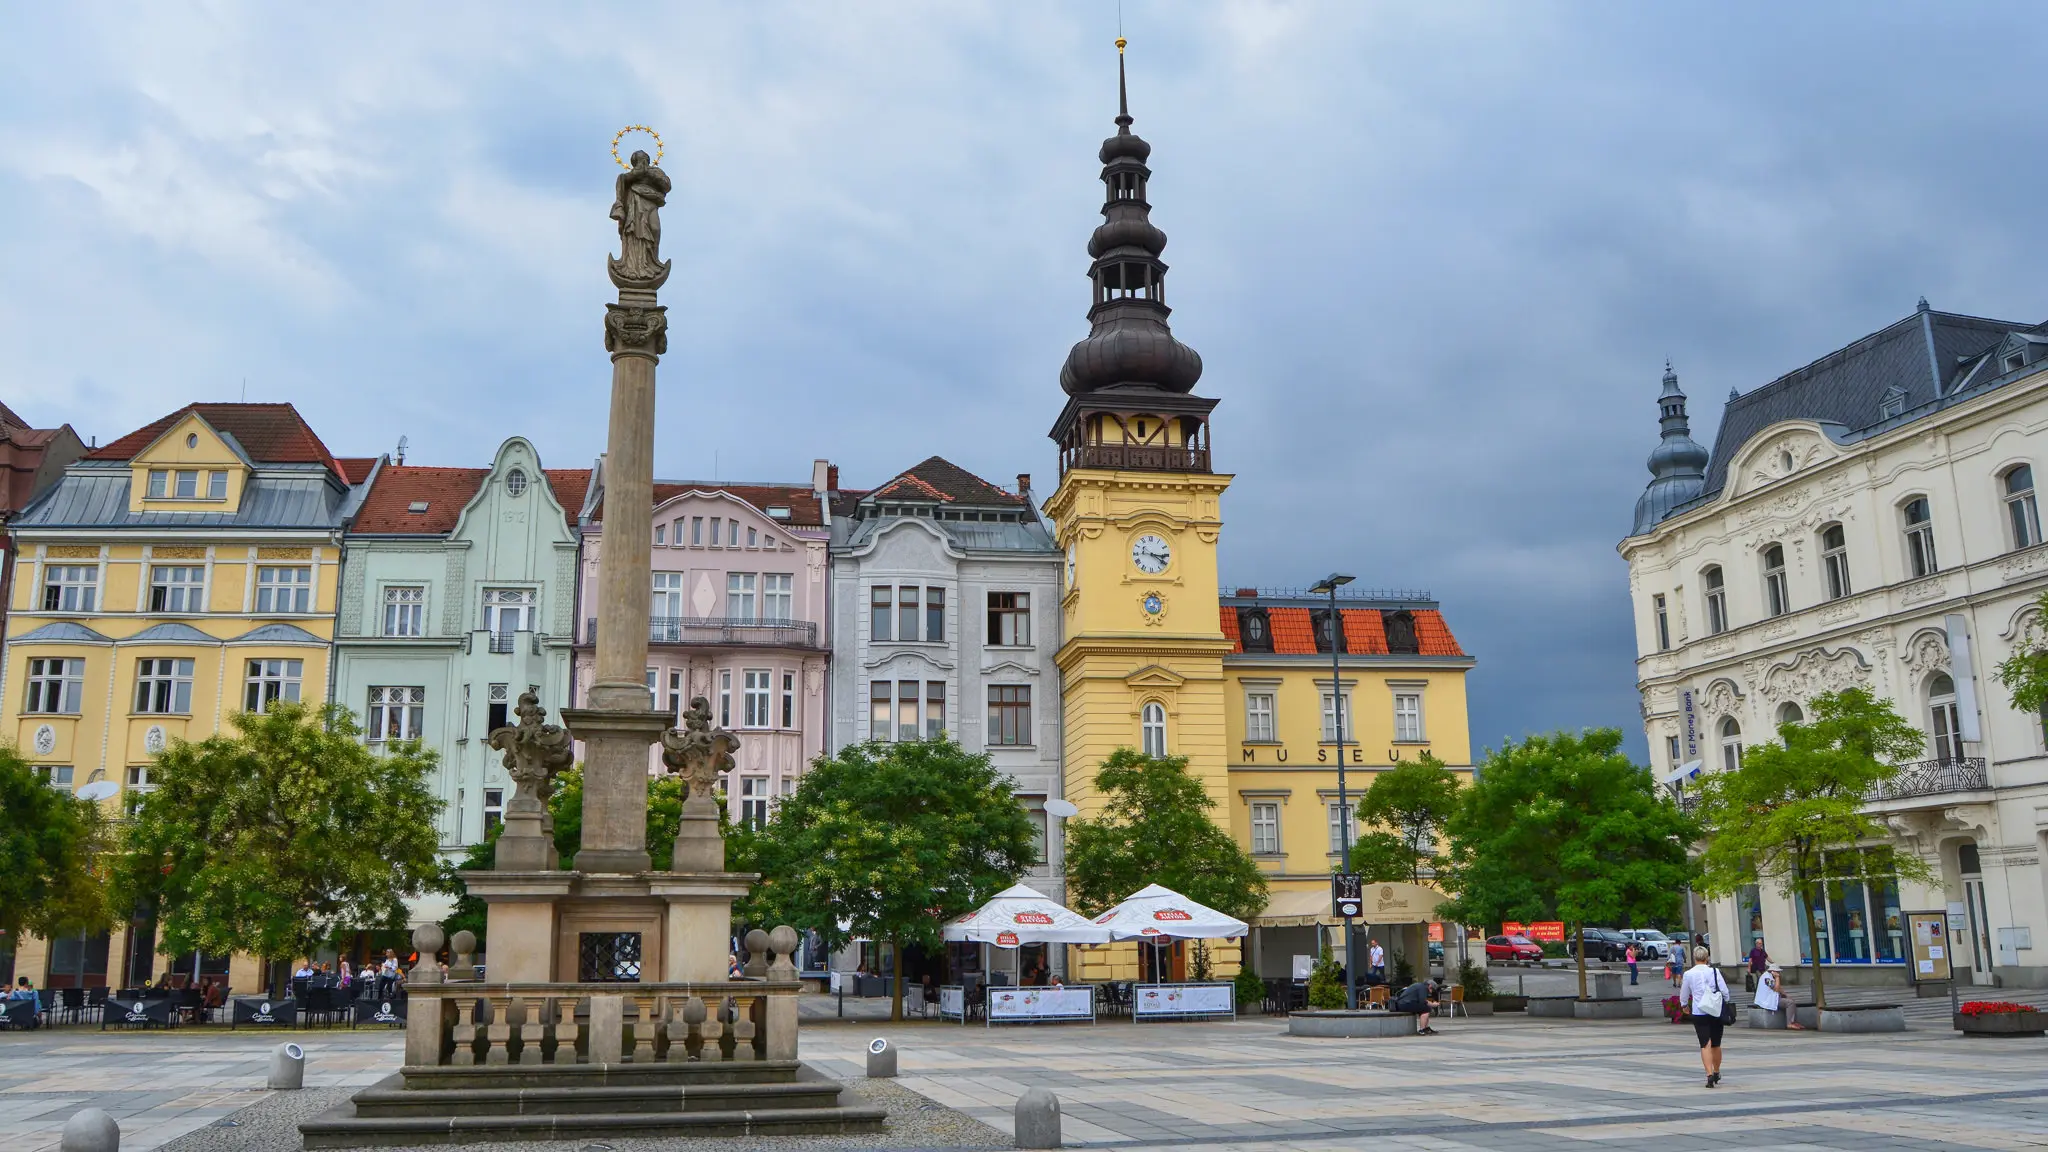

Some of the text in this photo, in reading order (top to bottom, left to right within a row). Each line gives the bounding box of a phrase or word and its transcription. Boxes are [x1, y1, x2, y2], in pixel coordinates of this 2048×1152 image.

[1684, 691, 1693, 712] Bank
[1243, 749, 1431, 762] MUSEUM
[1689, 743, 1696, 755] GE
